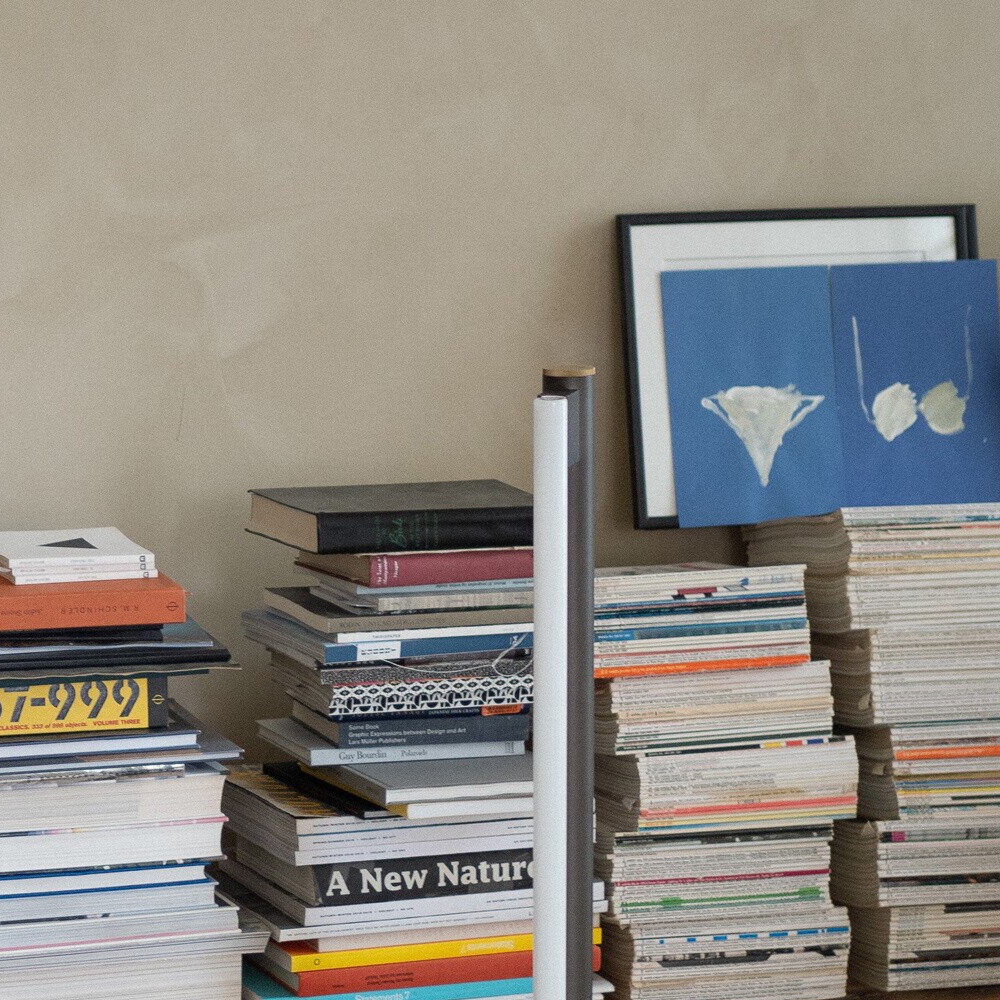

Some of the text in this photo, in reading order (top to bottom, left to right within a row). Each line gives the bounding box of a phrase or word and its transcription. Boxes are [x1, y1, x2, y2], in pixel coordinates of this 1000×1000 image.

[60, 605, 118, 615] SCHINDLER
[92, 719, 119, 727] VOLUME
[370, 729, 402, 737] Expressions
[402, 728, 426, 736] between
[426, 728, 446, 736] Design
[378, 736, 406, 744] Publishers
[338, 751, 356, 762] Guy
[356, 750, 388, 760] Bourdin
[325, 871, 351, 897] A
[359, 864, 429, 894] New
[404, 991, 411, 1000] 7
